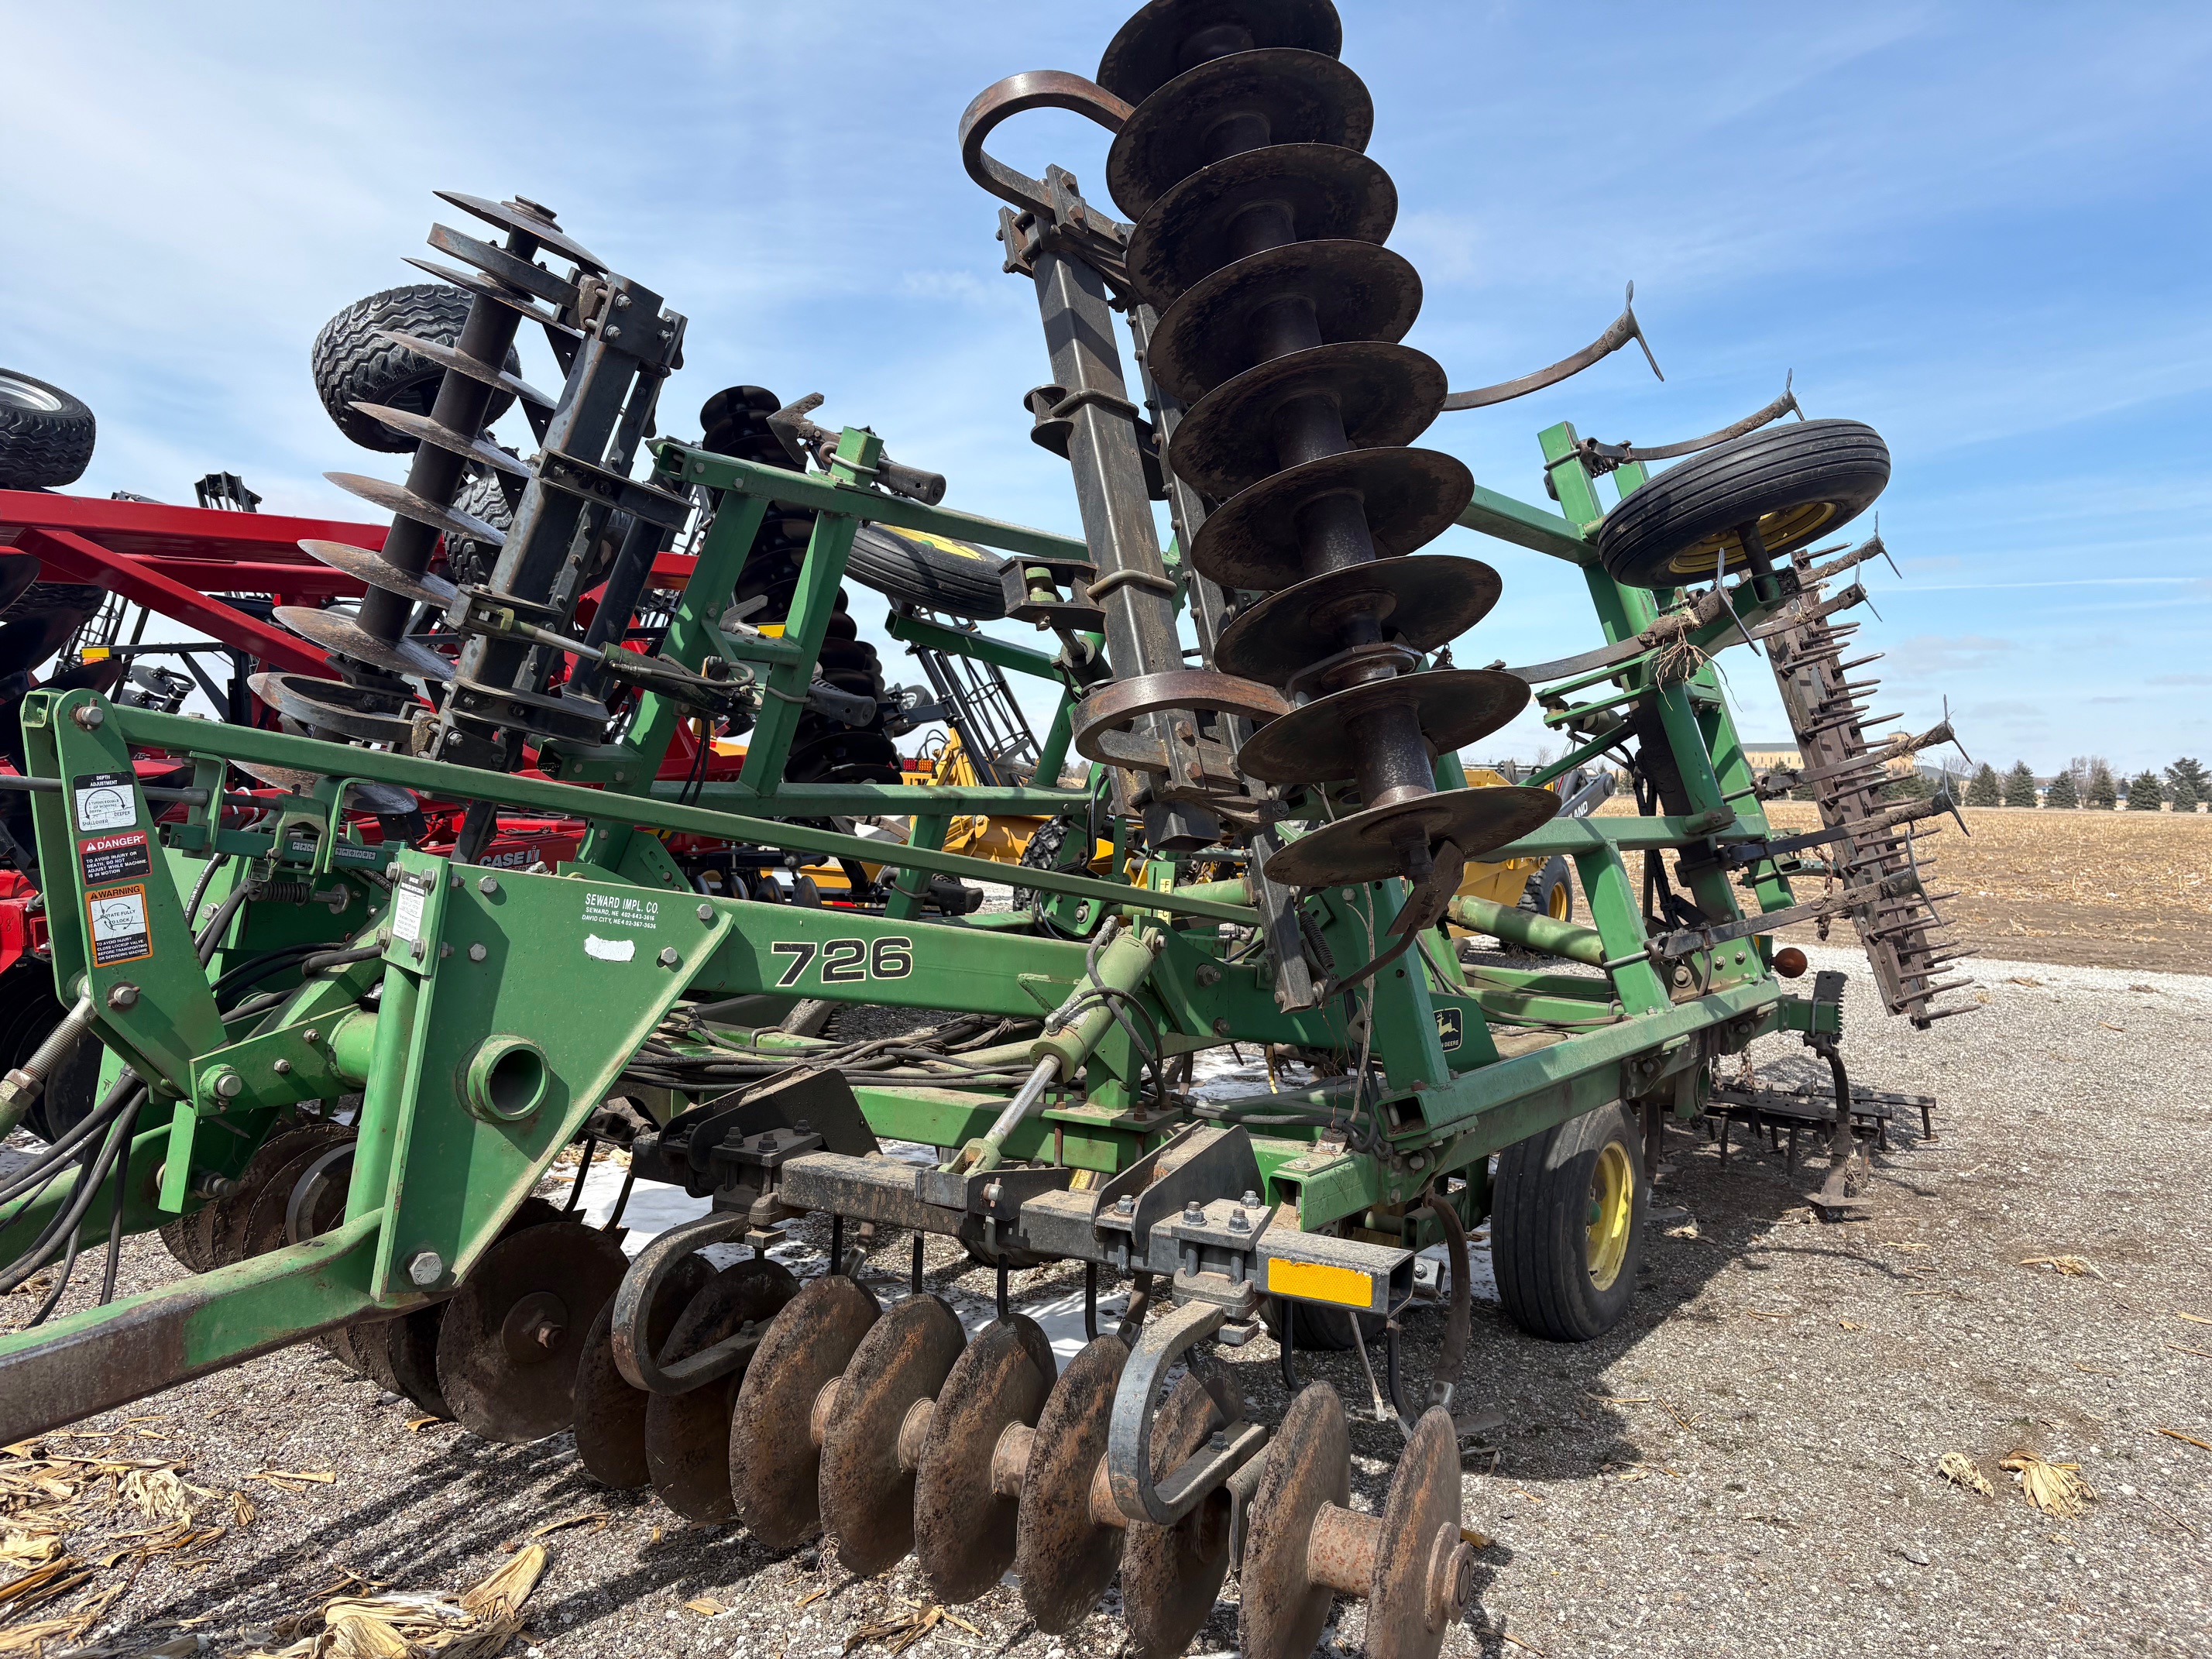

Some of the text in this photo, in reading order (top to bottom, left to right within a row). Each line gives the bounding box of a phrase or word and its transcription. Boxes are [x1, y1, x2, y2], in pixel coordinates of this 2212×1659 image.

[98, 836, 141, 850] DANGER
[479, 851, 525, 867] CASE
[98, 886, 139, 898] WARNING
[586, 893, 658, 914] SEWARD IMPL. CO.
[586, 907, 610, 915] SEWARD,
[771, 936, 912, 988] 726
